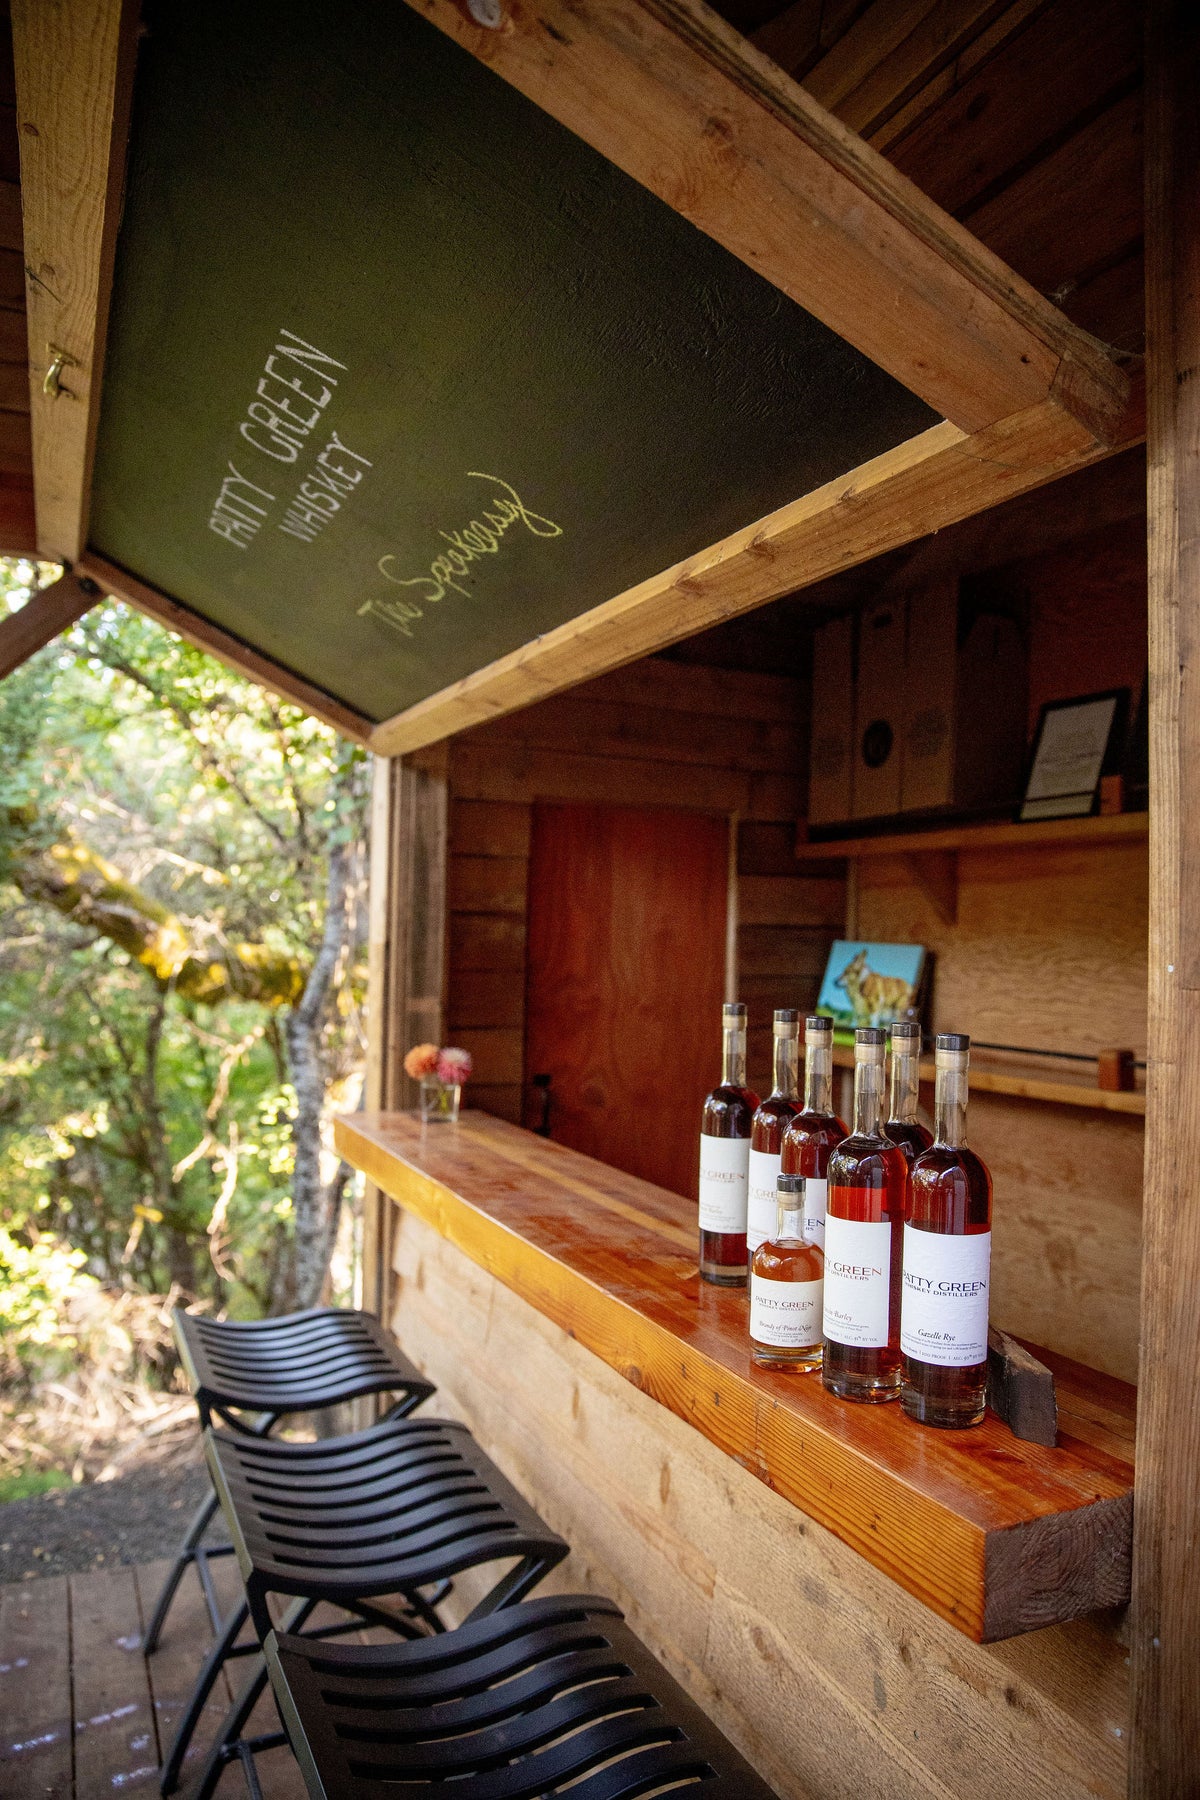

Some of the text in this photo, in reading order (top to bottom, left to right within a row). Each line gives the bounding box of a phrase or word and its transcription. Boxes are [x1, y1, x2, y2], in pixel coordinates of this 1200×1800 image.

[208, 328, 348, 549] PATTY GREEN
[278, 430, 373, 543] WHISKEY
[356, 599, 423, 637] The
[833, 1262, 882, 1277] GREEN
[938, 1279, 987, 1292] GREEN
[933, 1289, 978, 1298] DISTILLERS
[781, 1300, 815, 1309] GREEN
[917, 1328, 942, 1340] Gazelle
[943, 1332, 956, 1343] Rye
